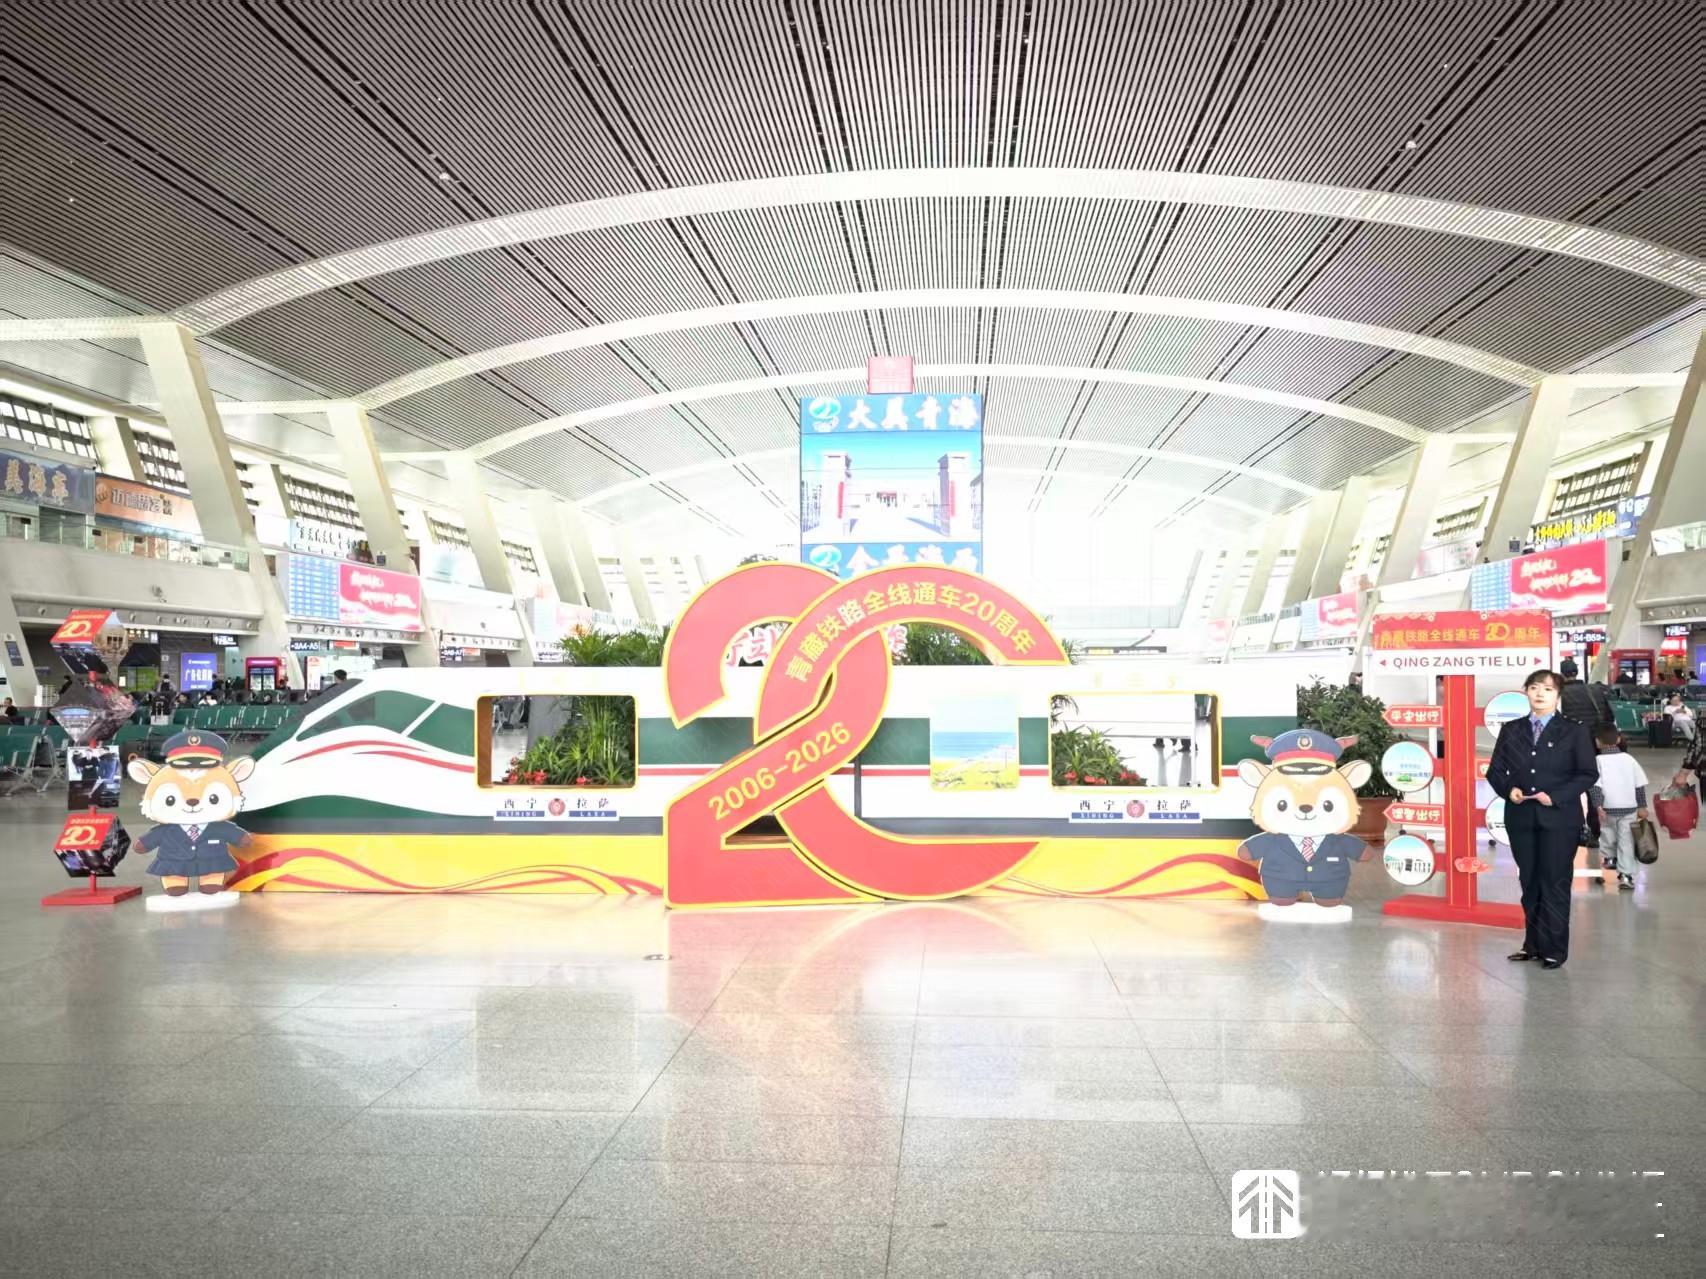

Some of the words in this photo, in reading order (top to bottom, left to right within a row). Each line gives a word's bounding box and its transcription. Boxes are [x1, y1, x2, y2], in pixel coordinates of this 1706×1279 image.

[785, 581, 1037, 683] 青藏铁路全线通车20周年
[1393, 657, 1429, 668] QING
[1433, 656, 1474, 667] ZANG
[1477, 656, 1504, 667] TIE
[1507, 655, 1527, 666] LU
[708, 721, 851, 821] 2006-2026
